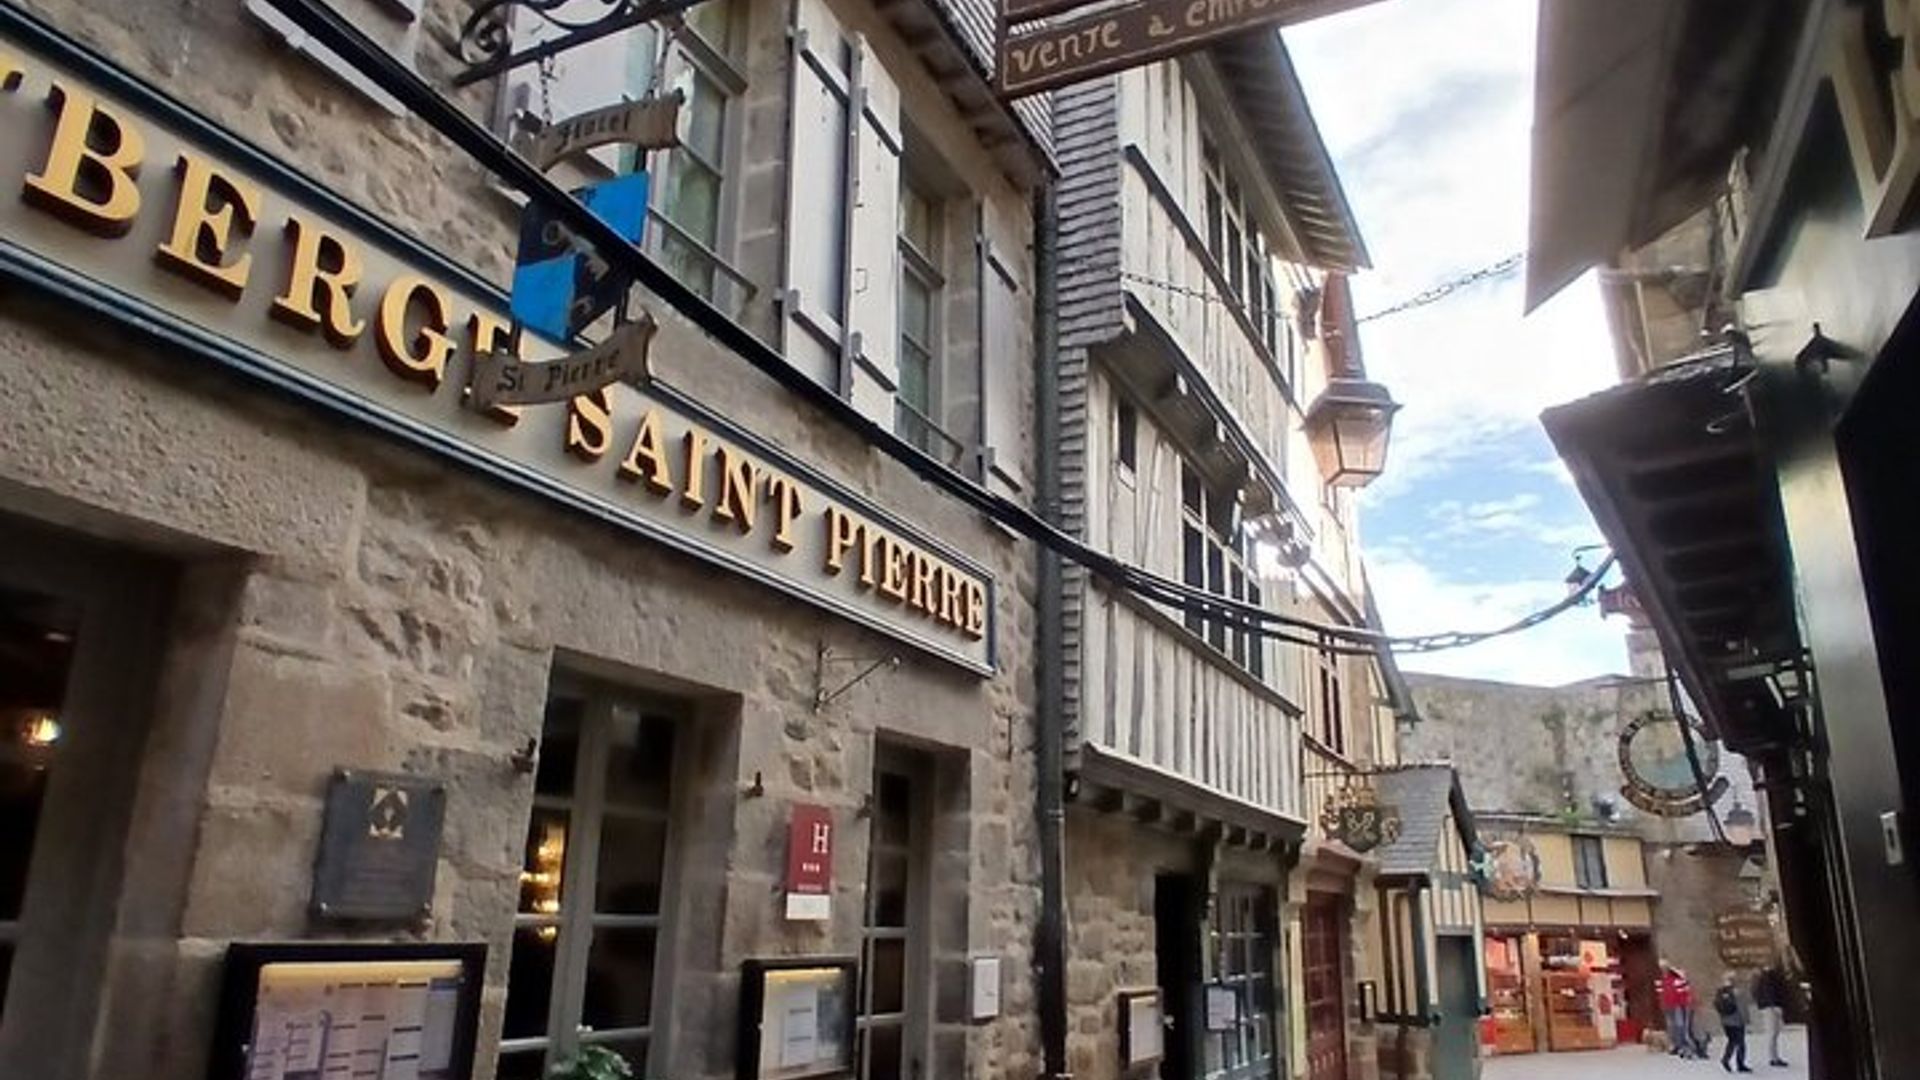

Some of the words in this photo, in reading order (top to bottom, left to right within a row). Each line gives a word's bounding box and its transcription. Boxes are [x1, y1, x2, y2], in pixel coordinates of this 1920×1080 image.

[544, 349, 620, 391] Pierre
[565, 383, 801, 553] SAINT
[824, 505, 984, 641] PIERRE
[812, 822, 829, 853] H
